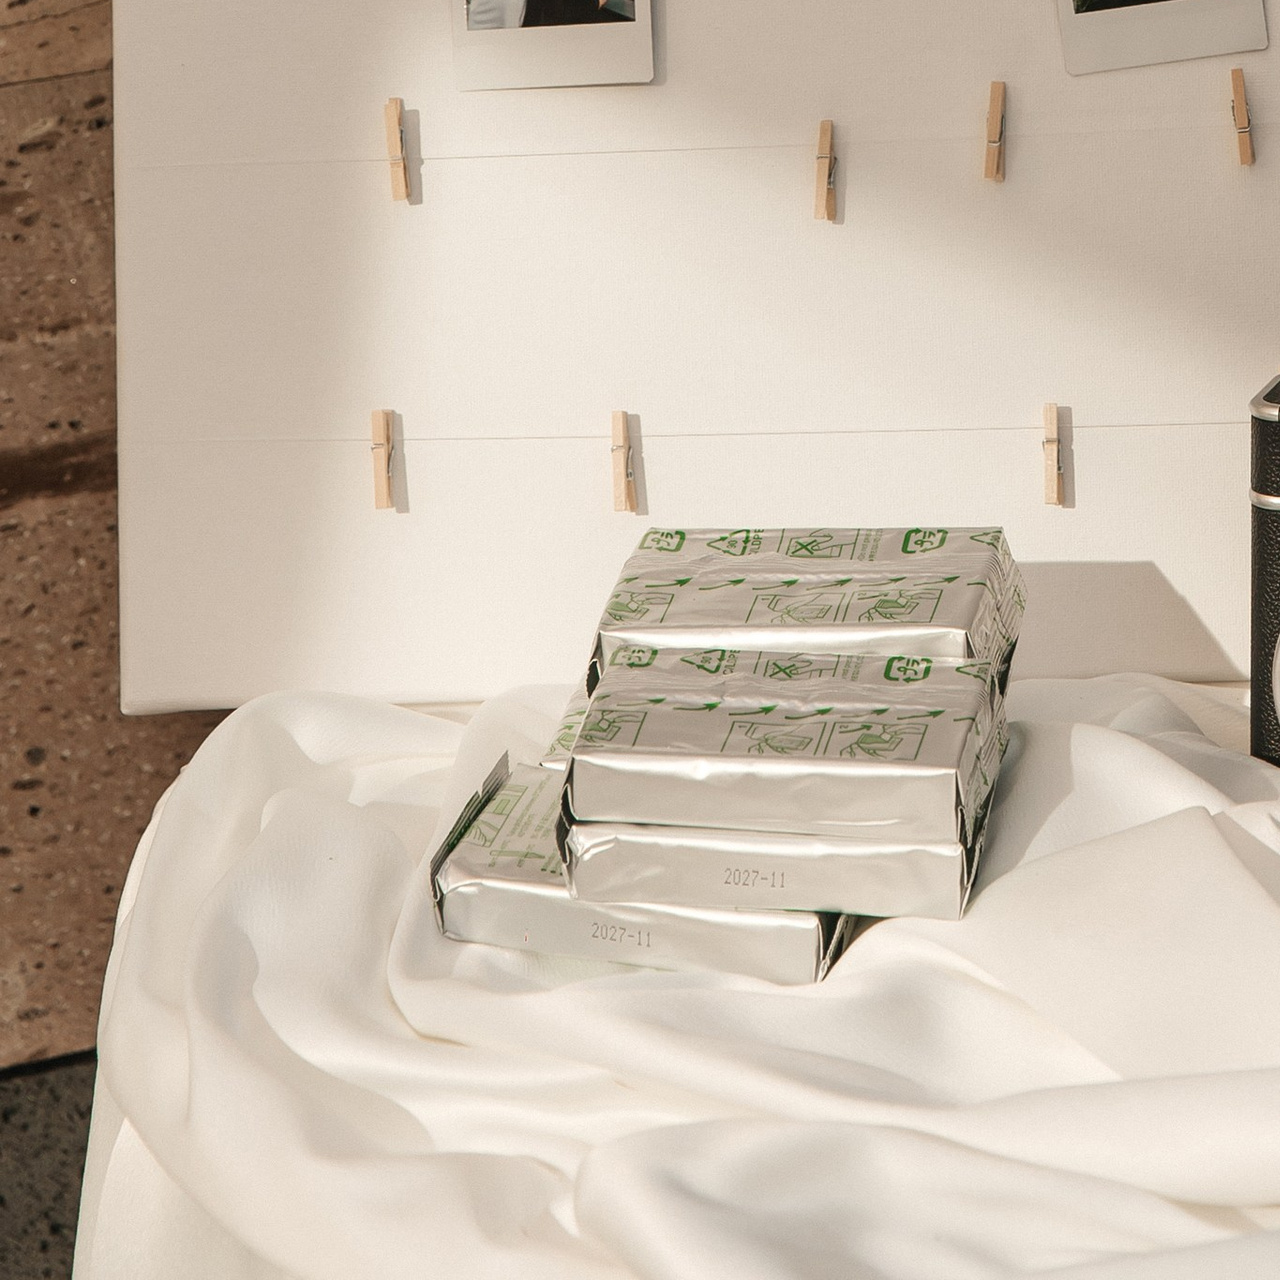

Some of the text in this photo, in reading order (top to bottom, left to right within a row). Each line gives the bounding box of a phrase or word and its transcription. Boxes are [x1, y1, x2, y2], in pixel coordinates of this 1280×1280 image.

[914, 530, 936, 548] プラ
[896, 658, 919, 676] プラ
[723, 867, 786, 889] 2027-11
[591, 922, 652, 948] 2027-11
